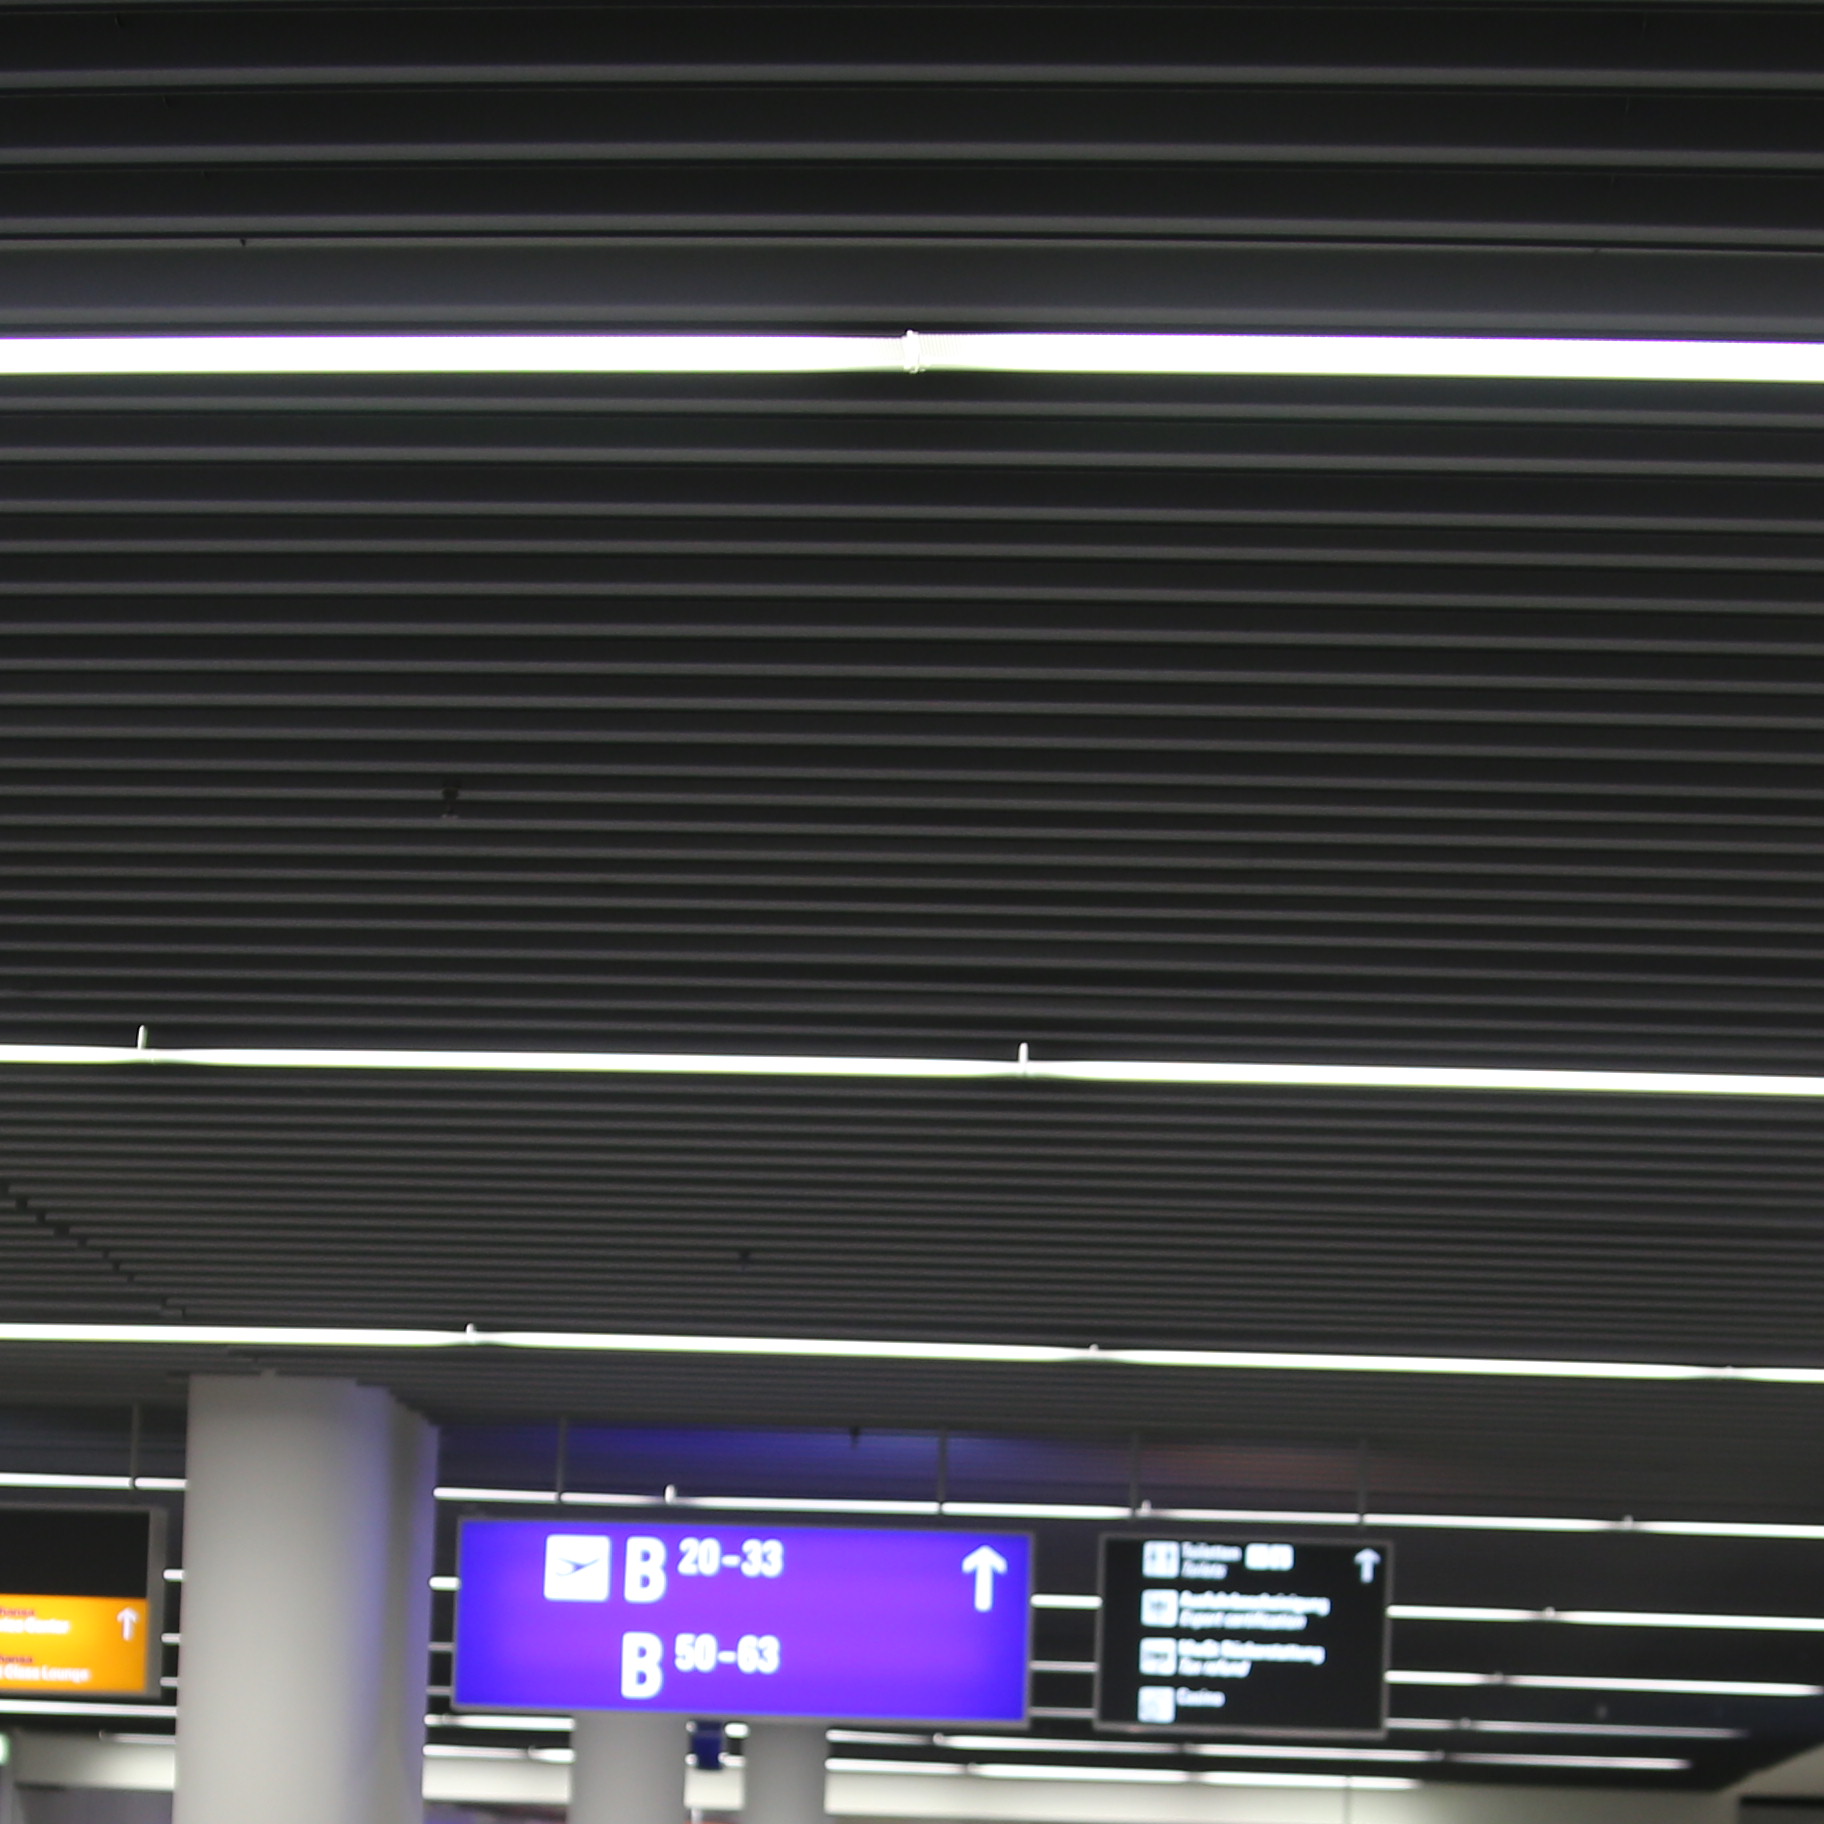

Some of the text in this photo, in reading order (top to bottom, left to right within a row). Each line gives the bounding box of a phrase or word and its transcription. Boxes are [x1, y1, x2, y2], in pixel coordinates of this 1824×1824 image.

[625, 1536, 783, 1603] B 20-33
[621, 1632, 663, 1699] B
